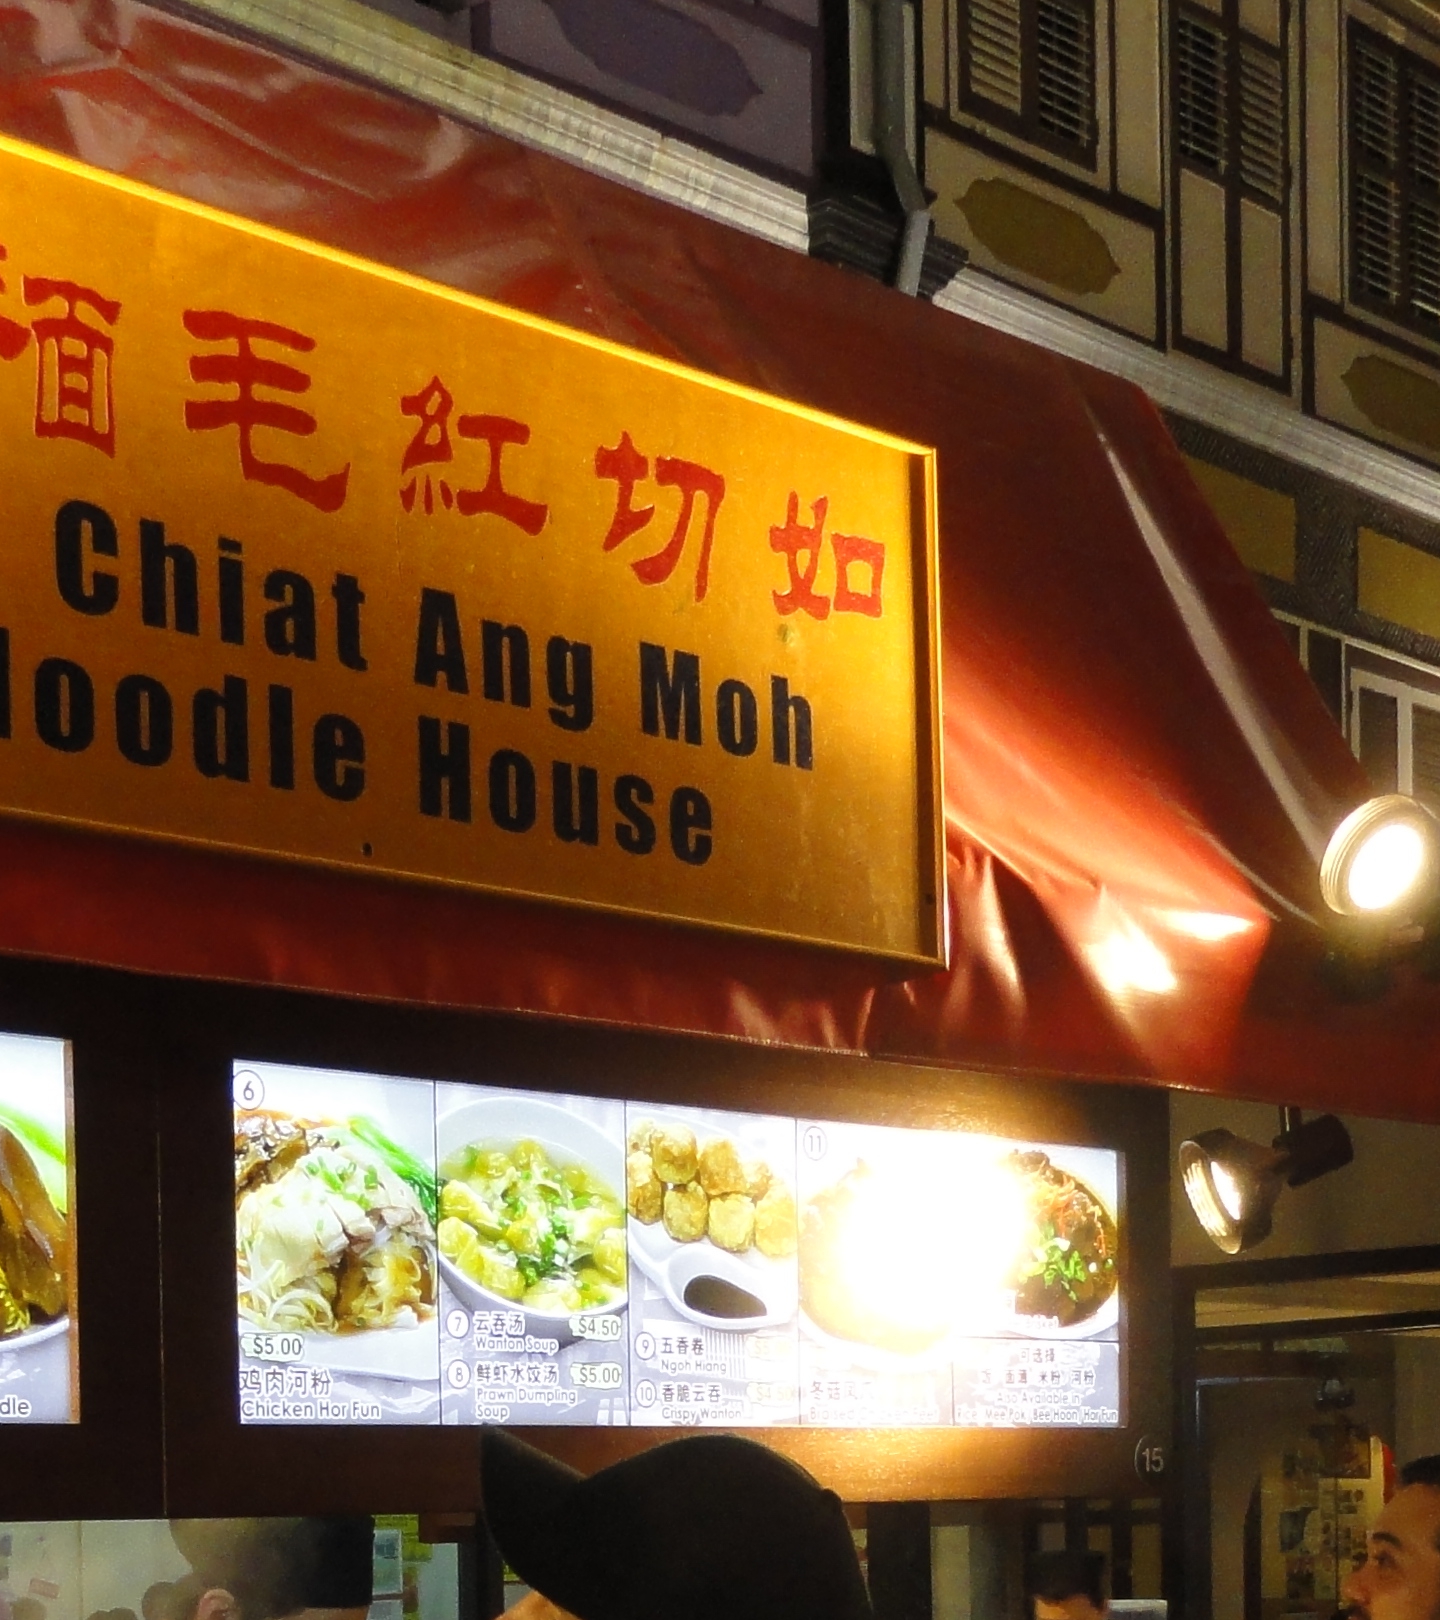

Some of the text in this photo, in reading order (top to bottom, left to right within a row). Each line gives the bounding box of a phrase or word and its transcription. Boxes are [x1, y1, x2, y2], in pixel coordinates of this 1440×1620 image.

[53, 498, 368, 676] Chiat
[413, 585, 596, 731] Ang
[639, 641, 814, 773] Moh
[416, 714, 713, 868] House
[241, 1078, 257, 1104] 6
[806, 1133, 825, 1155] 11
[473, 1312, 525, 1334] 云吞汤
[578, 1317, 620, 1337] $4.50
[252, 1336, 302, 1358] $5.00
[475, 1336, 558, 1354] Wanton Soup
[641, 1339, 650, 1355] 9
[455, 1366, 464, 1382] 8
[476, 1362, 559, 1384] 鲜虾水饺汤
[579, 1366, 621, 1384] $5.00
[661, 1360, 727, 1376] Ngoh Hiang
[239, 1369, 332, 1396] 鸡肉河粉
[477, 1389, 577, 1406] Prawn Dumpling
[639, 1386, 654, 1401] 10
[661, 1384, 722, 1404] 香脆云吞
[1022, 1391, 1068, 1405] Available
[240, 1399, 381, 1420] Chicken Hor Fun
[477, 1405, 509, 1420] Soup
[661, 1406, 742, 1422] Crispy Wanton
[985, 1408, 1006, 1421] Mee
[1033, 1410, 1051, 1422] Bee
[1102, 1411, 1118, 1423] Fun
[1141, 1447, 1165, 1473] 15
